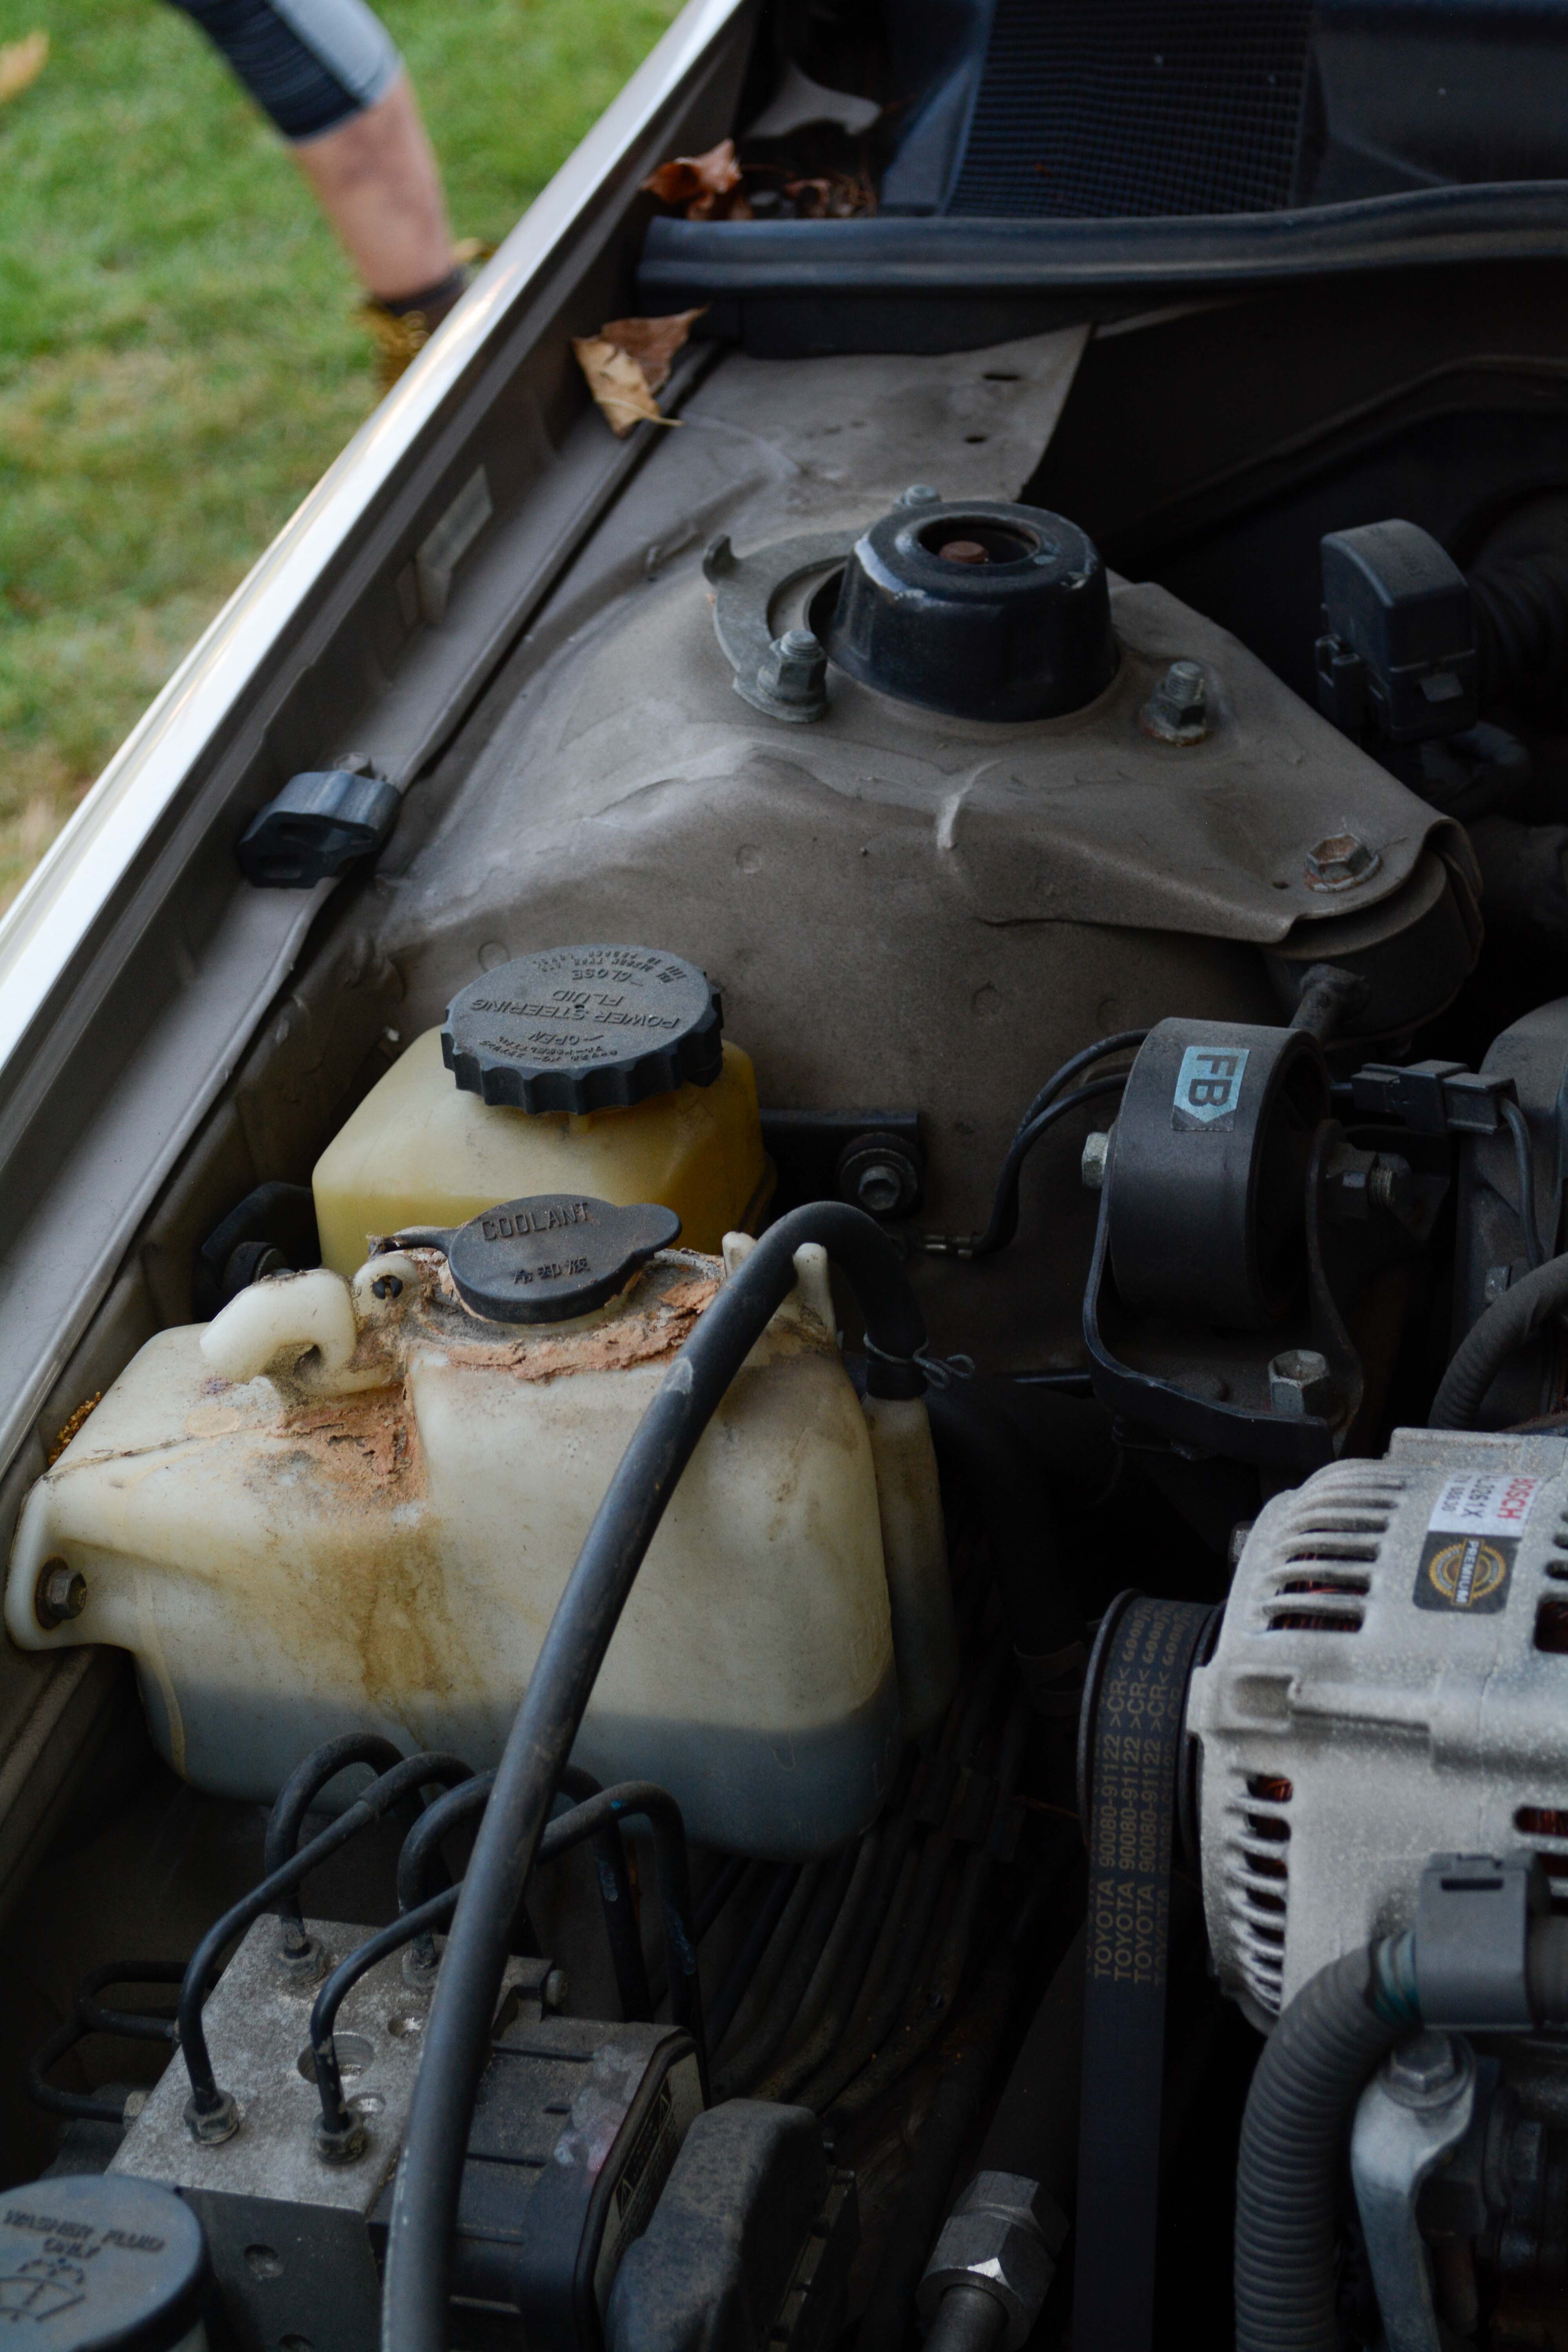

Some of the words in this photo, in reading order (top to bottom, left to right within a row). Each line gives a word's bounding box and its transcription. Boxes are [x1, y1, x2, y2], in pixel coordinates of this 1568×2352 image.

[552, 990, 624, 1006] FLUID
[571, 969, 632, 983] CLOSE
[470, 1000, 588, 1020] STEERING
[592, 1011, 679, 1029] POWER
[527, 1031, 580, 1045] OPEN
[1188, 1054, 1238, 1106] FB
[481, 1202, 589, 1241] COOLANT
[513, 1258, 590, 1284] 冷却液
[1497, 1478, 1538, 1519] BOSCH
[1455, 1541, 1479, 1603] PREMIUM
[1099, 1735, 1120, 1868] 90080-91122
[1119, 1737, 1140, 1870] 90080-91122
[1139, 1739, 1161, 1873] 90080-91122
[1094, 1878, 1114, 1978] TOYOTA
[1114, 1882, 1135, 1981] TOYOTA
[1134, 1884, 1154, 1984] TOYOTA
